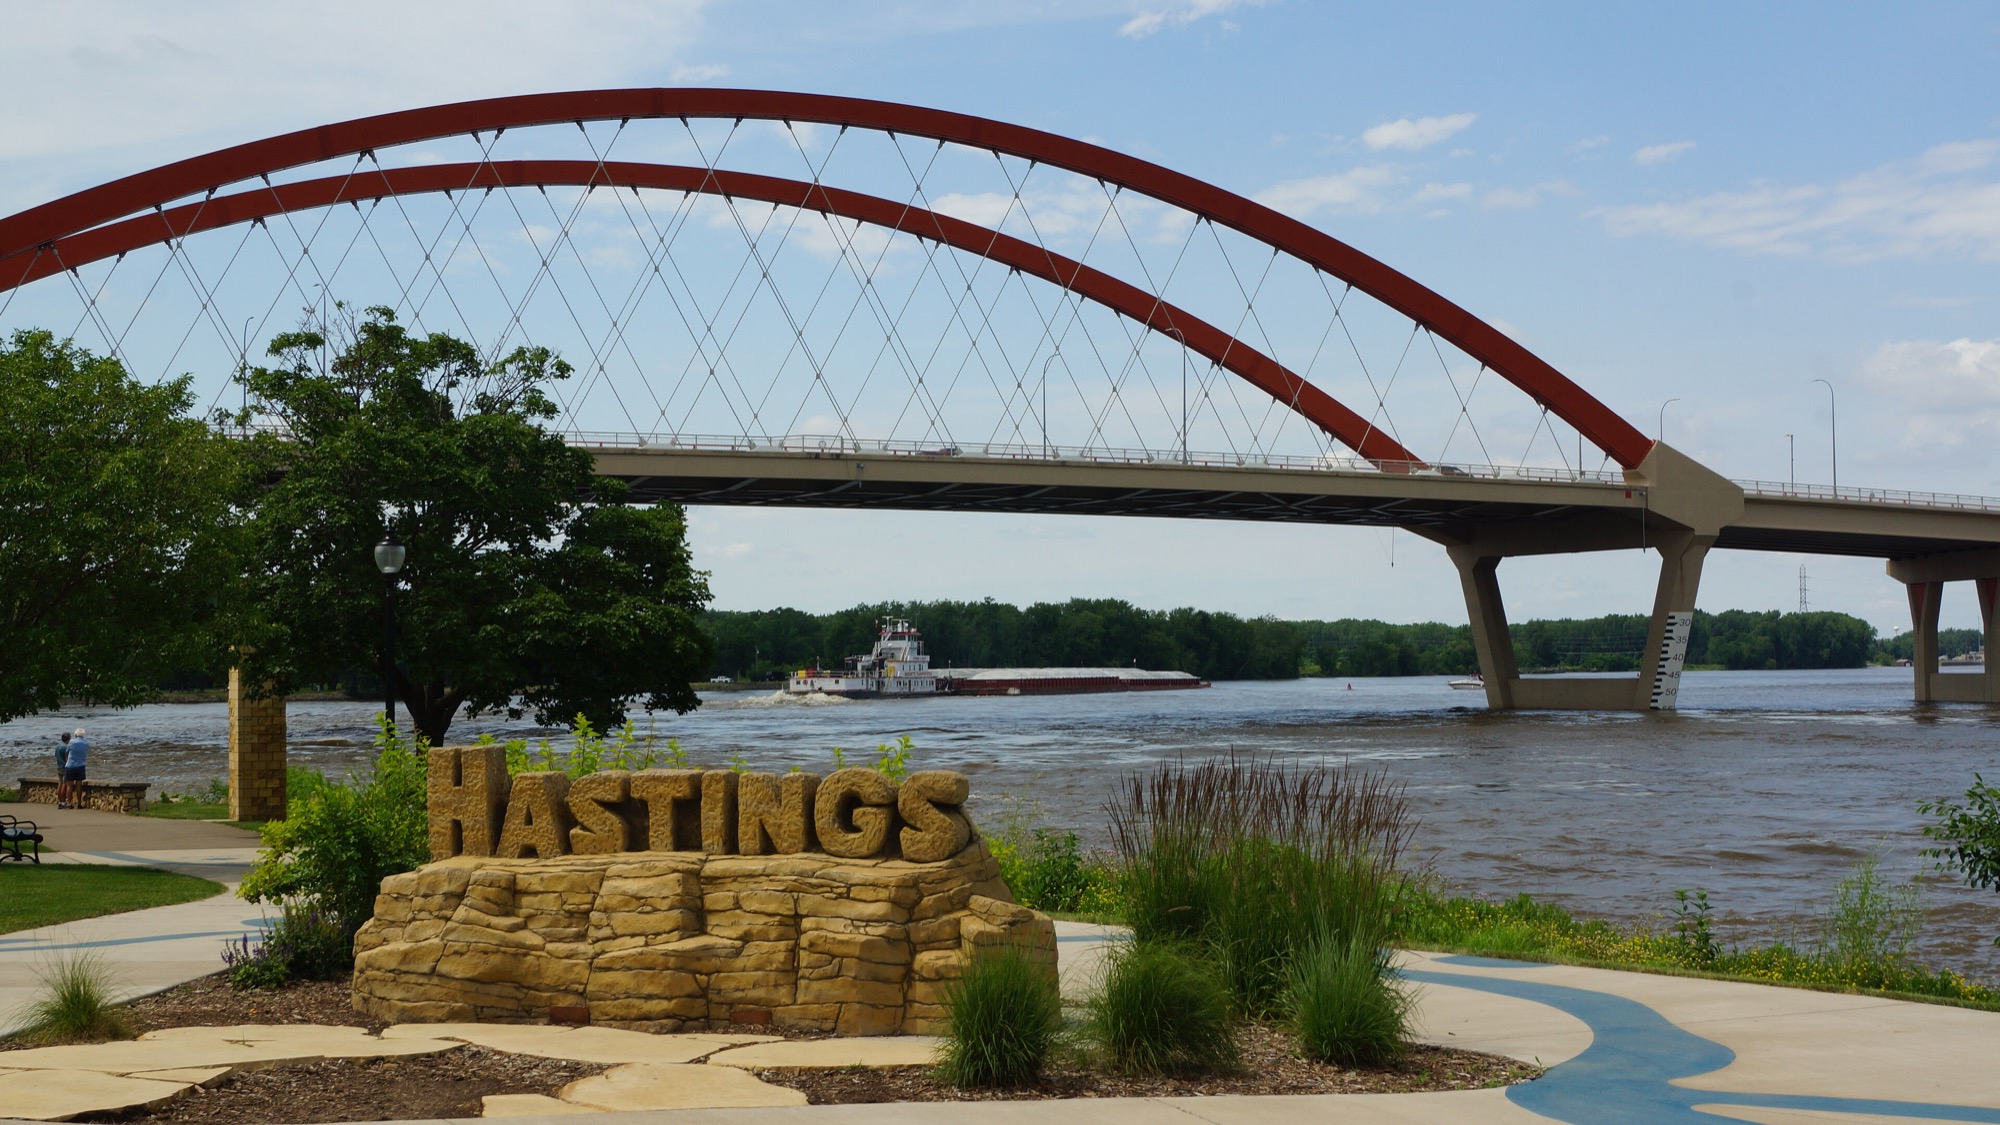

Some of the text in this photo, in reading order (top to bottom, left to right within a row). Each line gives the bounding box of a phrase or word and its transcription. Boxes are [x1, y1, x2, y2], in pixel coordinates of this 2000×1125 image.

[1679, 618, 1691, 627] 30
[1675, 636, 1688, 644] 35
[1672, 653, 1684, 661] 40
[1669, 671, 1680, 679] 45
[1665, 688, 1677, 696] 50
[428, 745, 970, 862] HASTINGS
